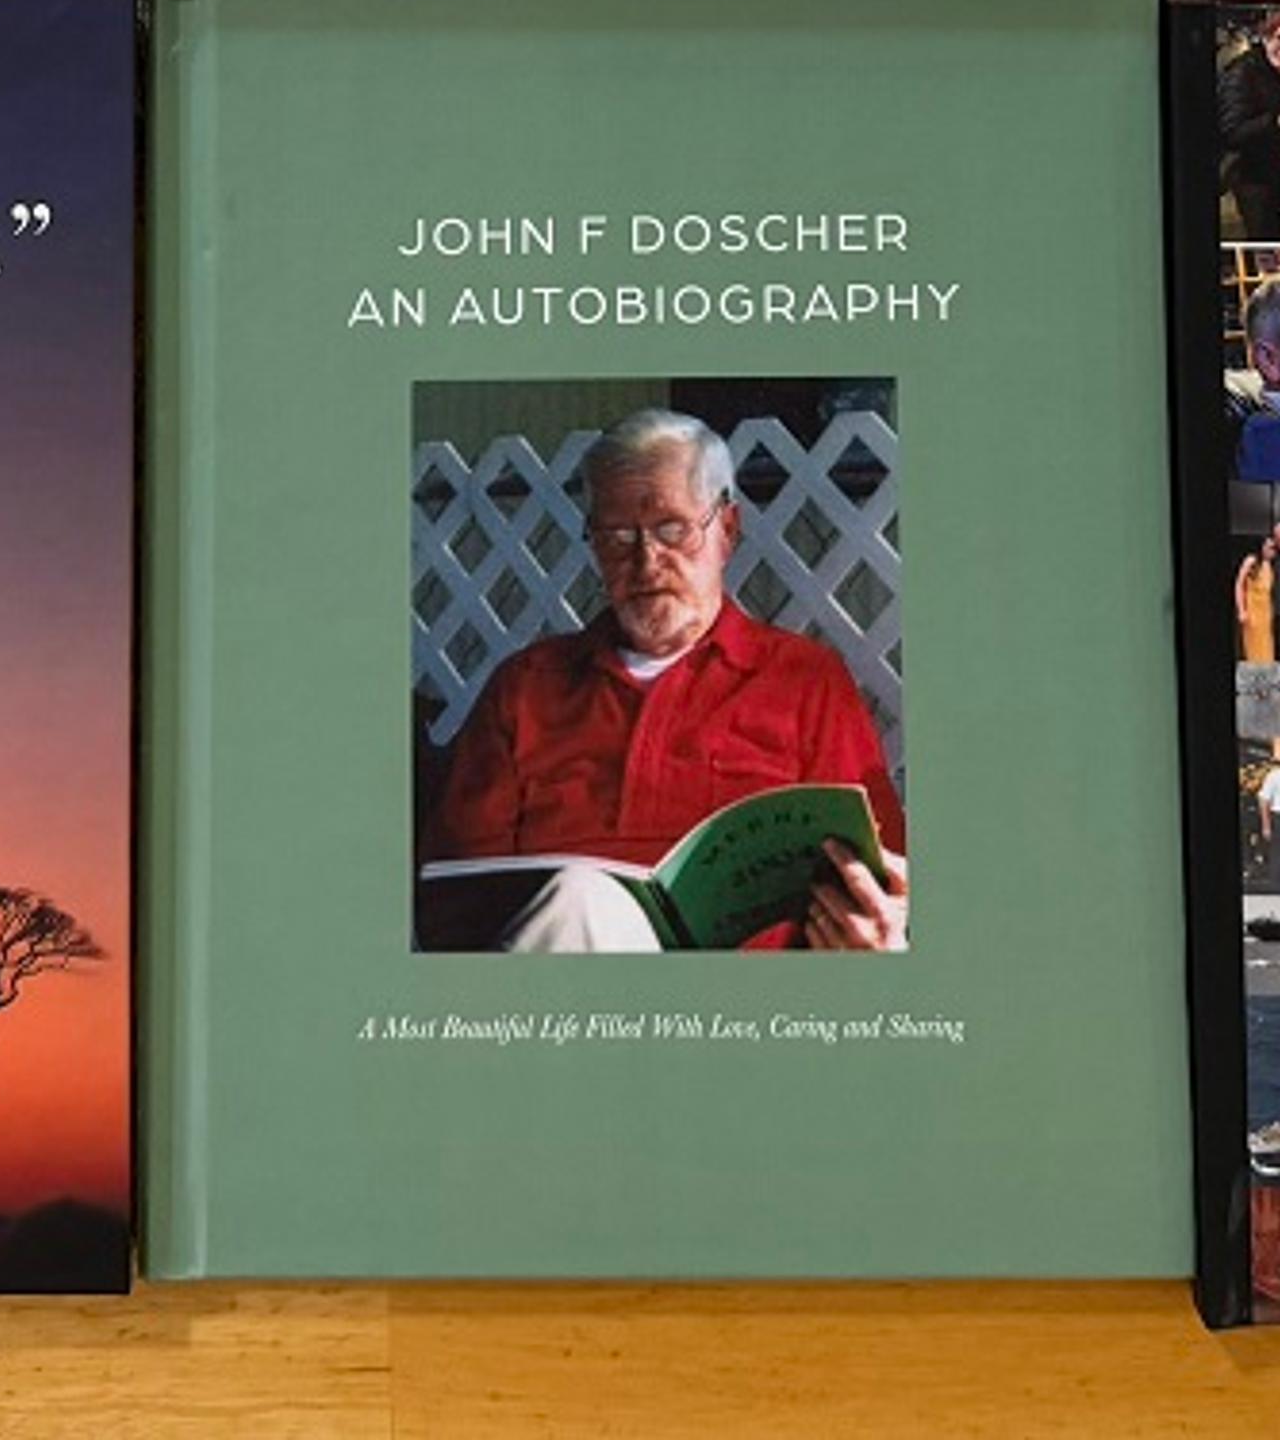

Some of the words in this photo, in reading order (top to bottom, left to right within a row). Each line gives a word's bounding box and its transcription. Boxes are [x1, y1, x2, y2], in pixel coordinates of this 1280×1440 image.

[399, 218, 553, 255] JOHN
[582, 217, 606, 253] F
[633, 215, 906, 253] DOSCHER
[349, 289, 424, 327] AN
[451, 284, 959, 324] AUTOBIOGRAPHY
[359, 1018, 374, 1039] A
[383, 1018, 434, 1038] Most
[442, 1015, 533, 1044] Beautiful
[540, 1014, 578, 1044] Life
[586, 1015, 644, 1038] Filled
[654, 1014, 702, 1037] With
[710, 1014, 760, 1039] Love,
[770, 1015, 837, 1042] Caring
[844, 1014, 883, 1037] and
[887, 1014, 963, 1042] Sharing
